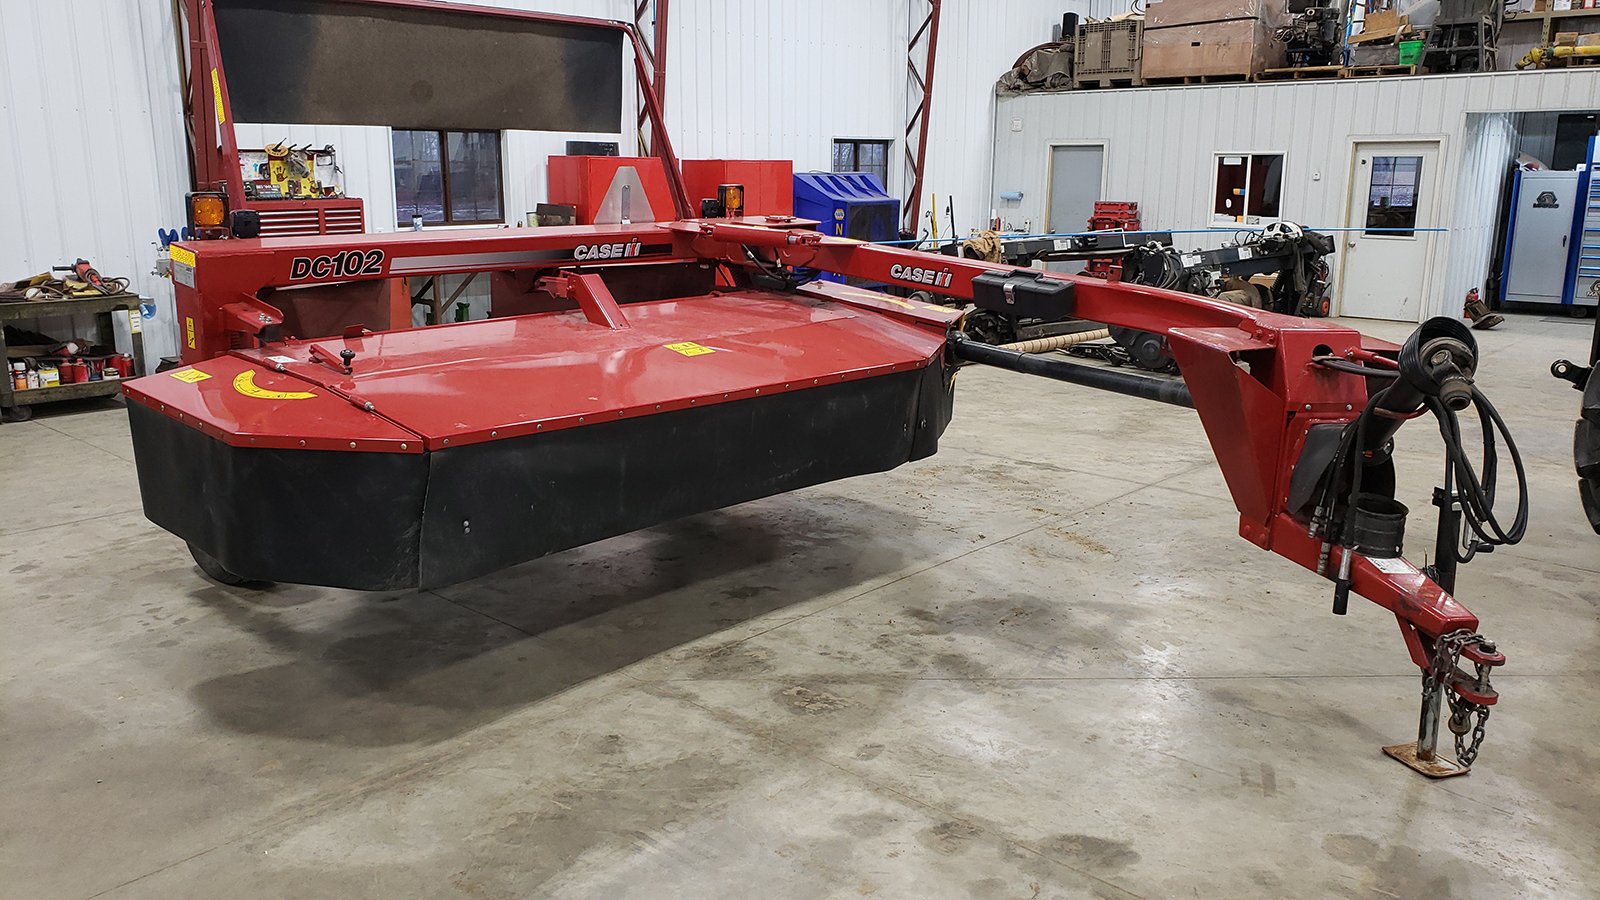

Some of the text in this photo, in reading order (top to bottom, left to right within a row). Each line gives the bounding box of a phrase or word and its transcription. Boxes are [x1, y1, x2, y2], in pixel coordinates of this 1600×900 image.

[574, 243, 624, 261] CASE
[290, 248, 385, 280] DC102
[890, 263, 936, 285] CASE
